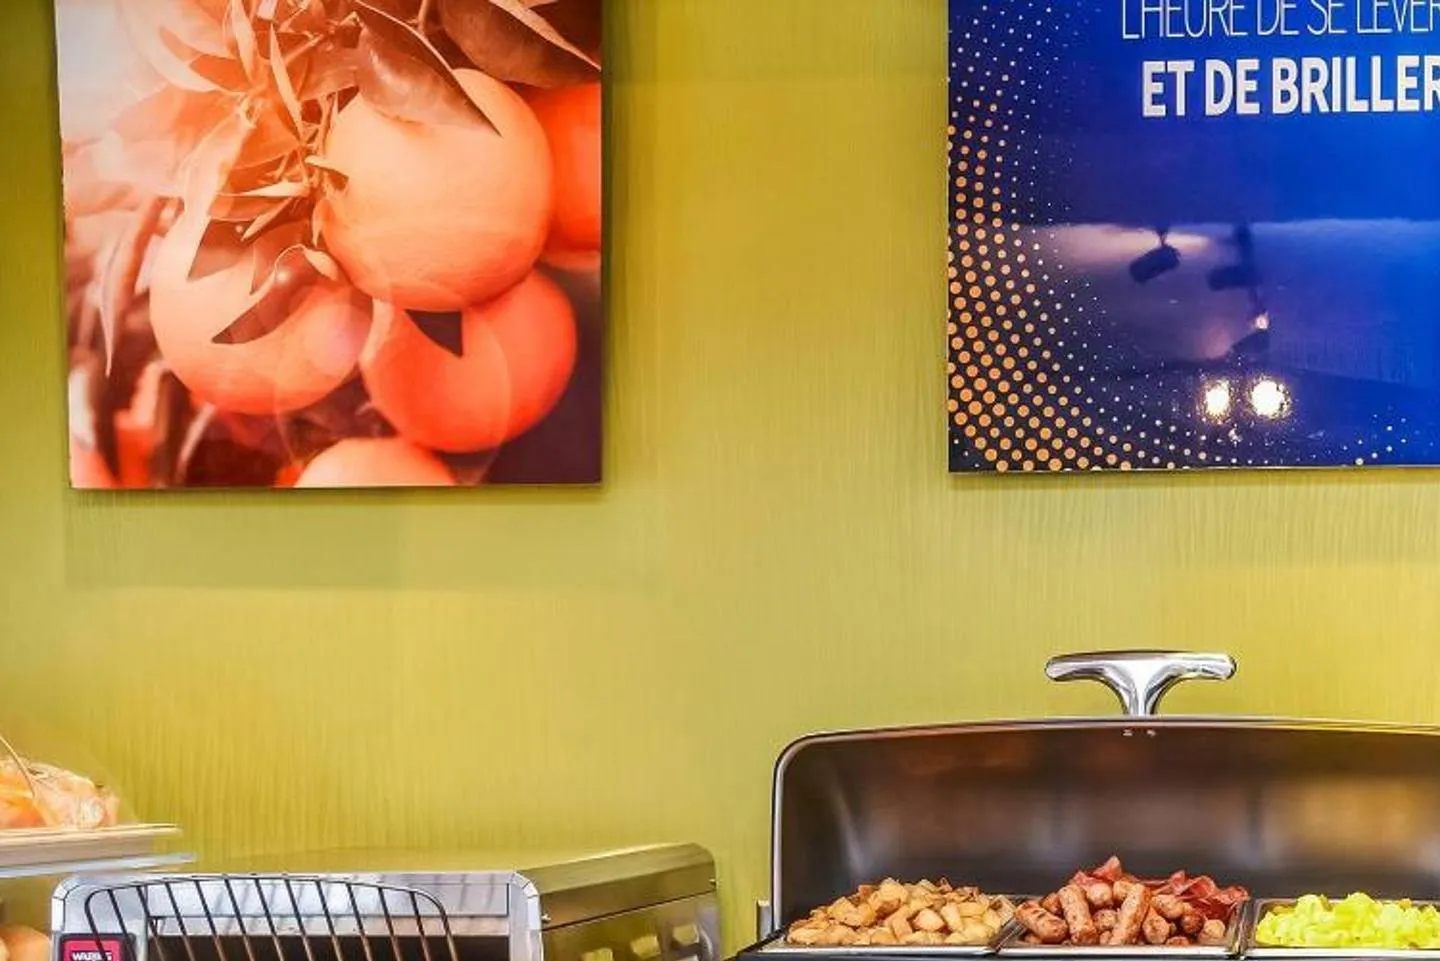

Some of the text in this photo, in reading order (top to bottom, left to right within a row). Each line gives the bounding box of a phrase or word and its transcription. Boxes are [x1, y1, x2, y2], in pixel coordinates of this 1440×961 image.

[1257, 0, 1299, 36] DE
[1307, 0, 1347, 34] SE
[1142, 60, 1195, 117] ET
[1205, 58, 1260, 116] DE
